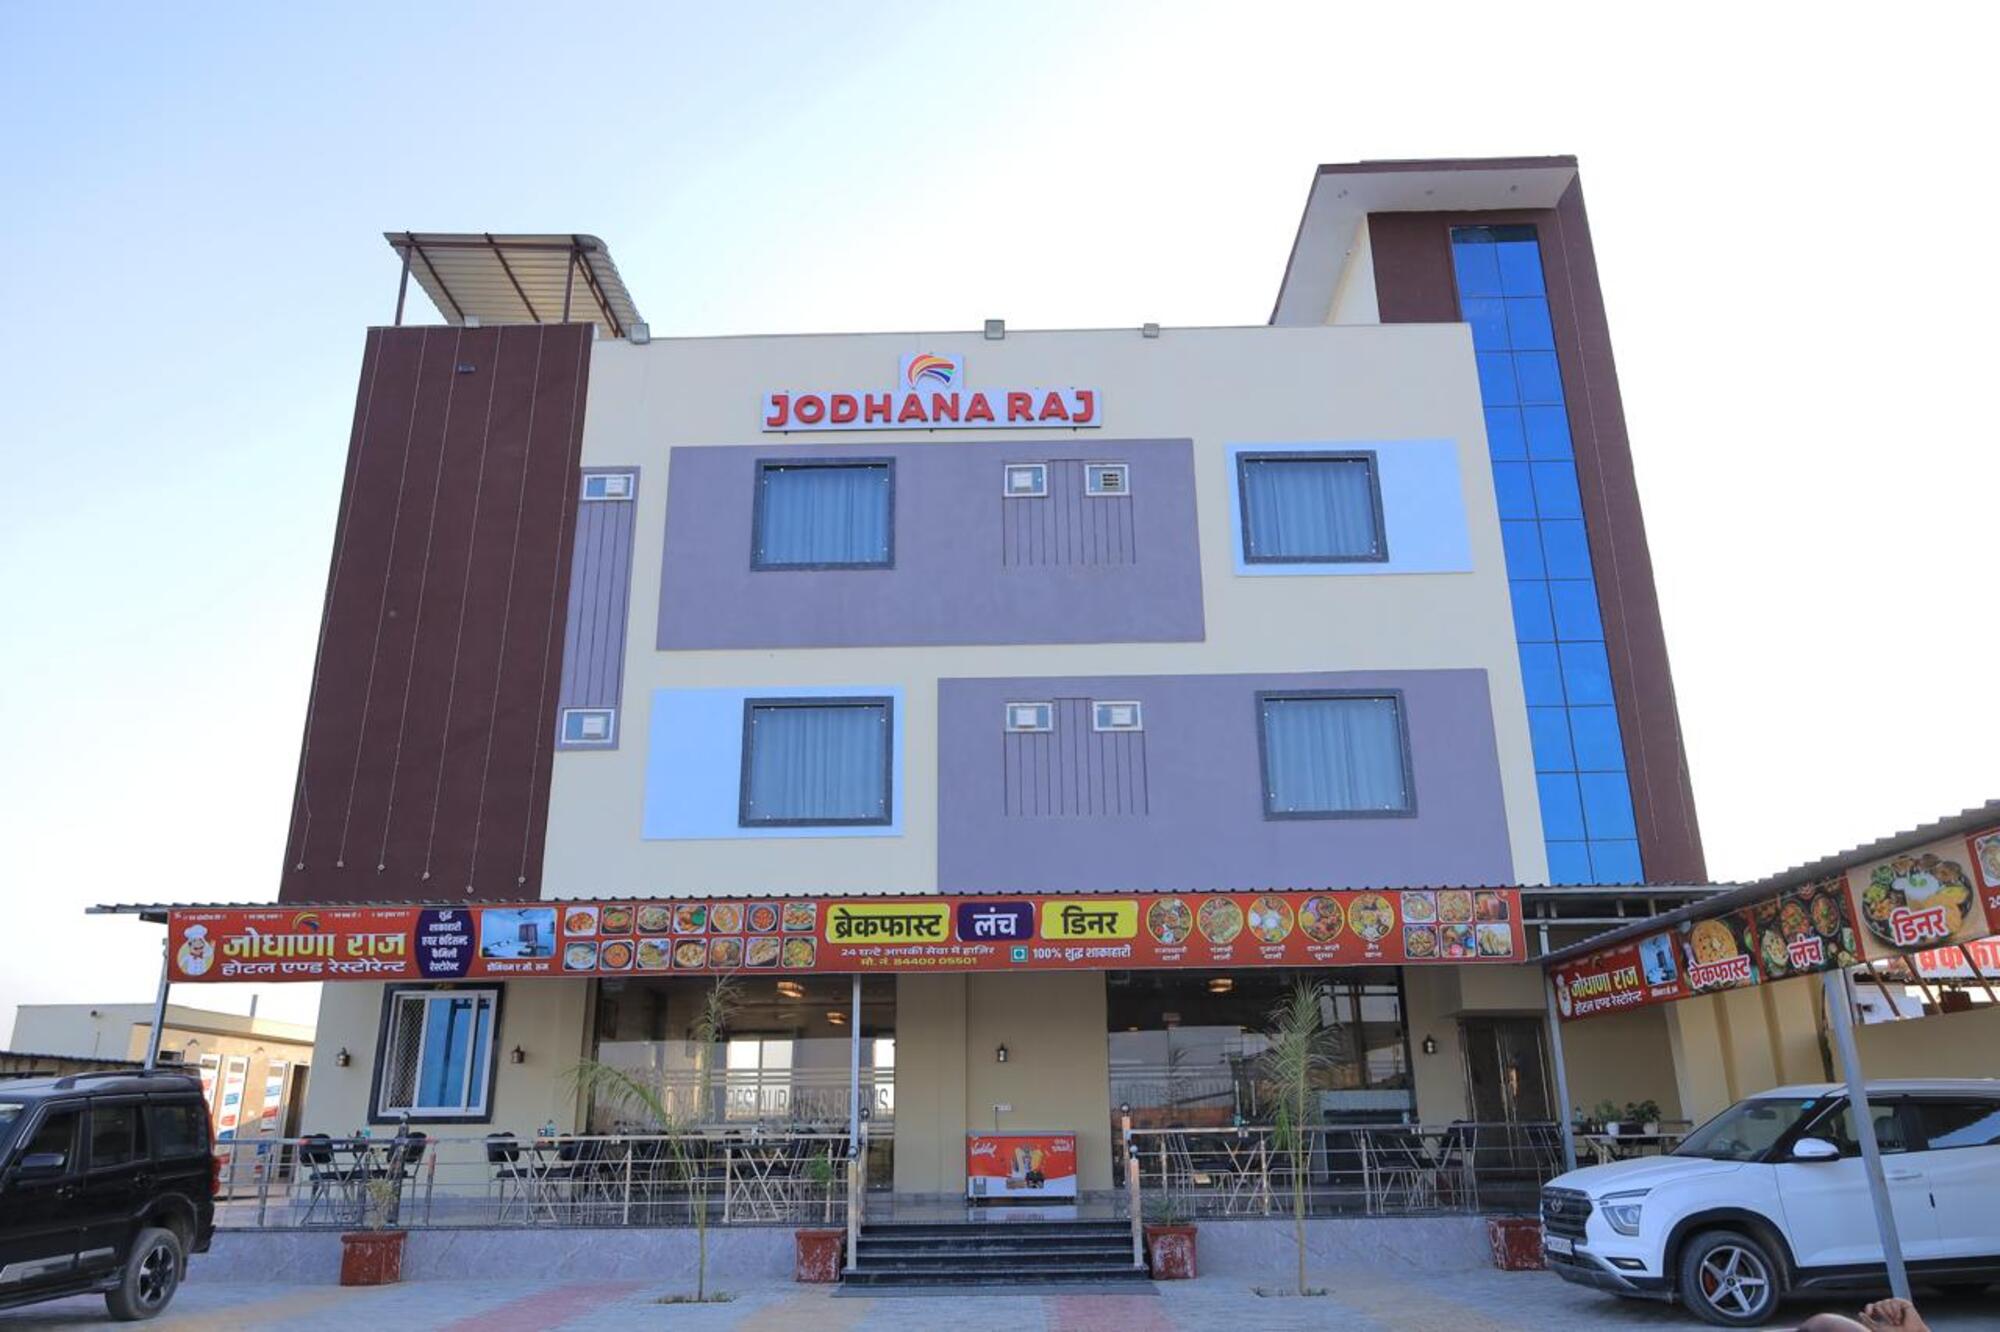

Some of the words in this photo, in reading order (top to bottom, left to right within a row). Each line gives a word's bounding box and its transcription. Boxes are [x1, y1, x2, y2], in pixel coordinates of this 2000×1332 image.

[767, 391, 994, 427] JODHANA
[1006, 390, 1094, 423] RAJ
[833, 907, 943, 938] ब्रेकफास्ट
[973, 906, 1018, 937] लंच
[1061, 905, 1119, 935] डिनर
[1891, 908, 1948, 945] डिनर
[222, 927, 336, 958] जोधाणा
[346, 932, 407, 957] राज
[1032, 948, 1062, 959] 100%
[1789, 934, 1823, 967] लंच
[221, 959, 276, 976] होटल
[280, 961, 324, 974] एण्ड
[1612, 966, 1639, 989] राज
[1689, 955, 1750, 987] ब्रेकफास्ट
